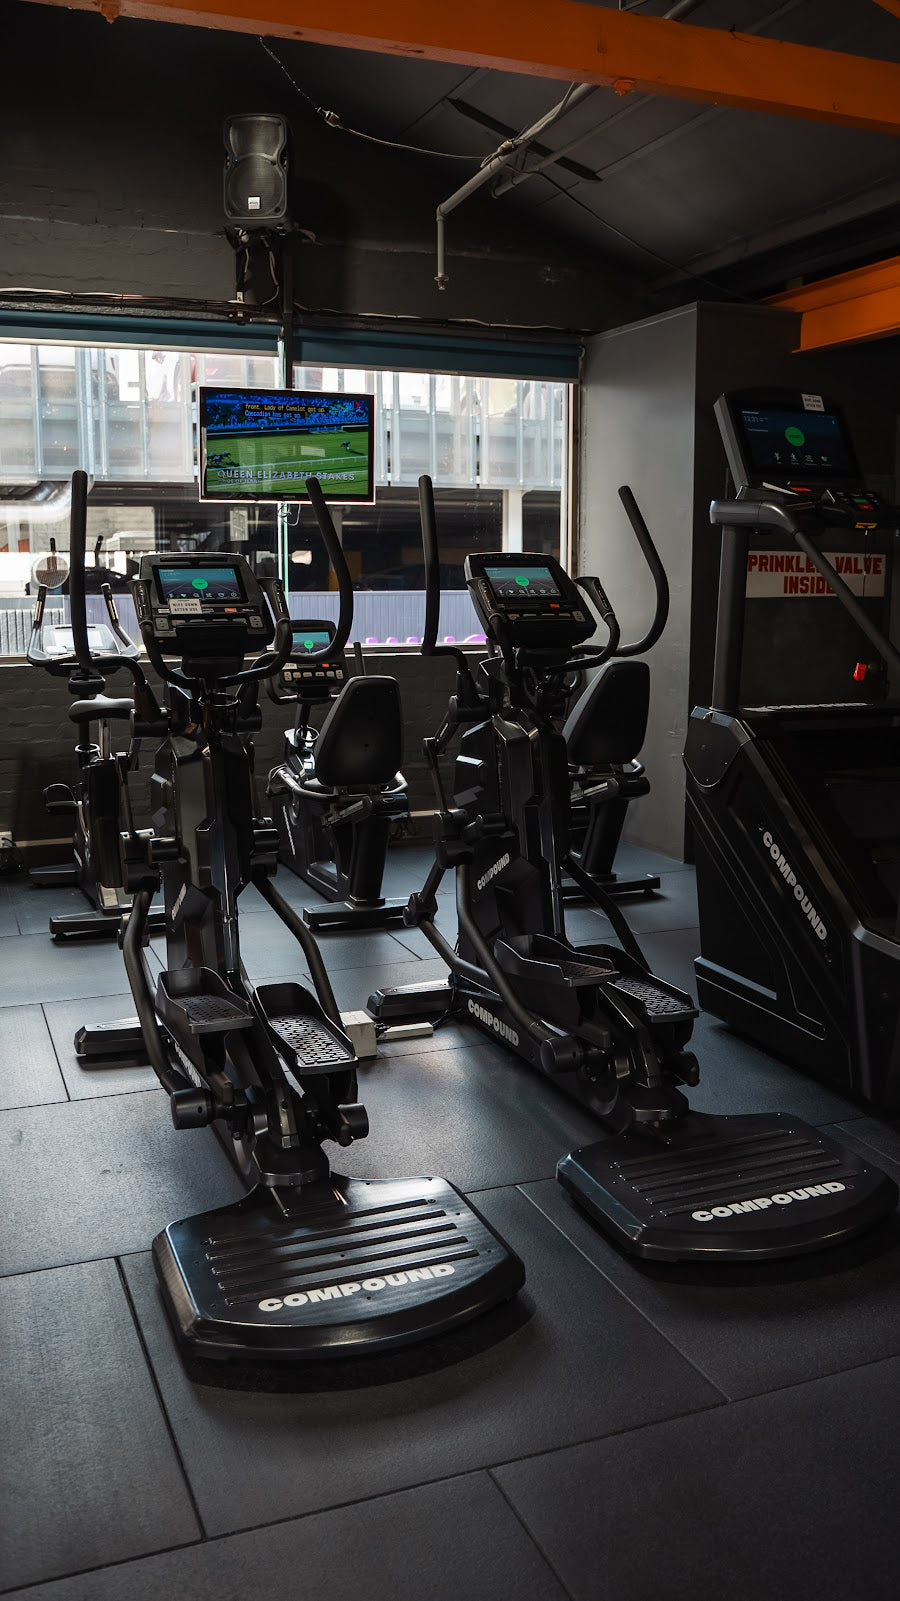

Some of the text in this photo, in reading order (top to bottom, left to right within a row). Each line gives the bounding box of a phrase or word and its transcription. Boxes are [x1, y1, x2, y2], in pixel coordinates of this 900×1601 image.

[217, 469, 355, 481] QUEEN ELIZABETH STAKES
[747, 554, 883, 575] PRINKLE VALVE
[477, 852, 510, 891] COMPOUND
[762, 831, 828, 941] COMPOUND
[467, 998, 520, 1047] COMPOUND
[691, 1181, 846, 1222] COMPOUND
[258, 1264, 456, 1312] COMPOUND
